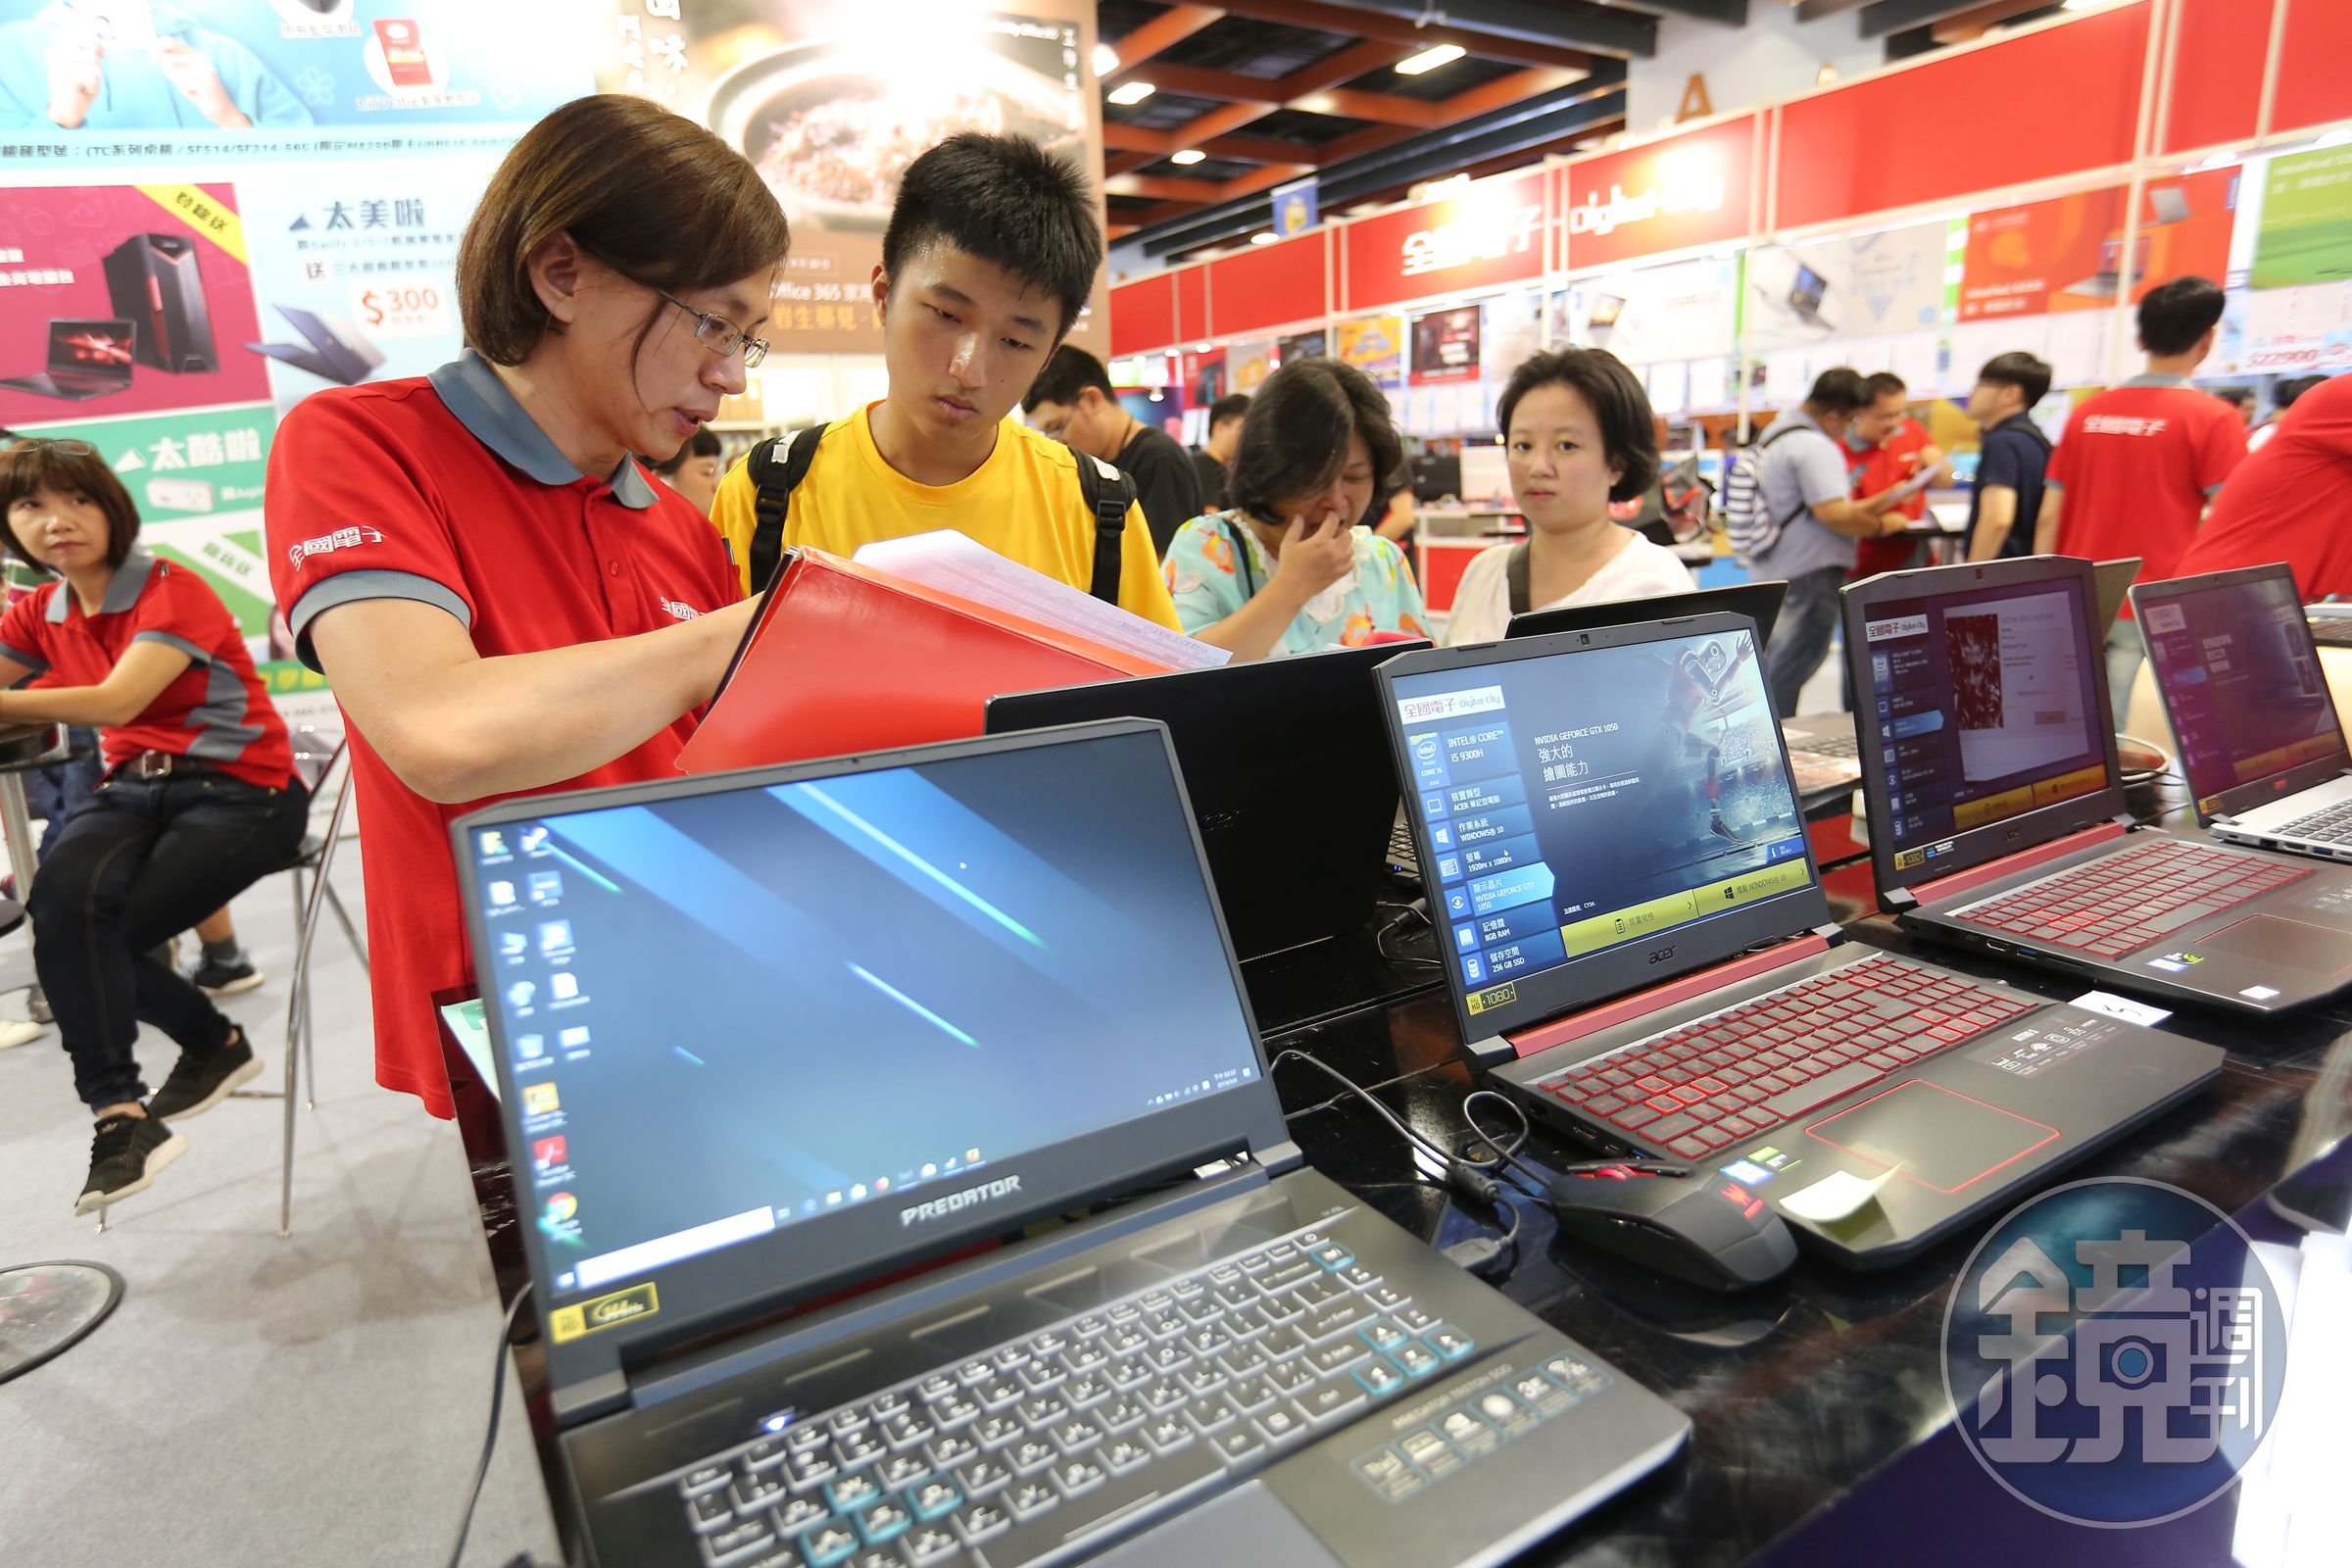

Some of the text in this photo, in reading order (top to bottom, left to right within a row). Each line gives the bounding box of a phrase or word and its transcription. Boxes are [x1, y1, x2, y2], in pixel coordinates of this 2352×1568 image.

[323, 200, 424, 229] 太美啦
[362, 288, 439, 327] $300
[288, 525, 387, 571] 全國電子
[1404, 698, 1456, 718] 全國電子
[1534, 722, 1619, 745] NVIDIA GEFORCE GTX 1050
[1459, 748, 1484, 761] 9300H
[1537, 744, 1573, 763] 強大的
[1543, 760, 1589, 782] 繪圖能力
[1453, 802, 1471, 811] ACER
[1475, 892, 1496, 903] NVIDIA
[1496, 884, 1523, 897] GEFORCE
[1478, 901, 1492, 911] 1050
[1484, 928, 1511, 942] 8GB RAM
[1648, 945, 1678, 964] acer
[1492, 956, 1525, 973] 256 GB SSD
[1485, 988, 1510, 1005] 1080
[901, 1174, 1022, 1226] PREDATOR
